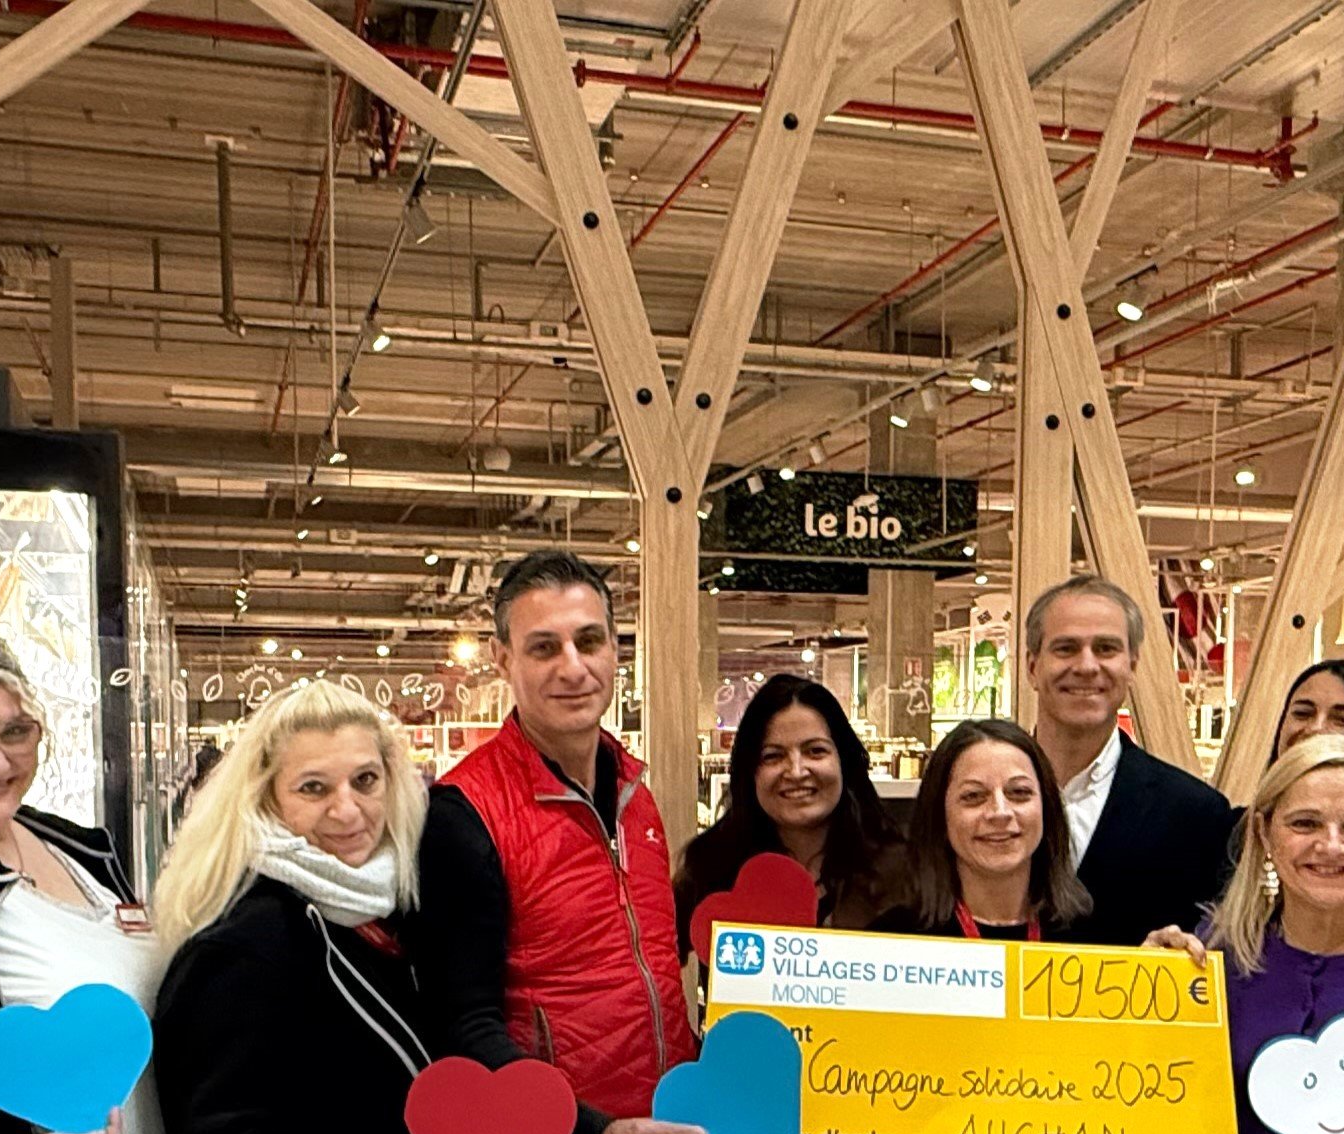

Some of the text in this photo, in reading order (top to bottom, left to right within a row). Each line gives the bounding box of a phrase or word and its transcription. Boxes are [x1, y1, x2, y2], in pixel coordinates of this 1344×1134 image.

[805, 503, 902, 540] le bio
[773, 936, 818, 956] SOS
[772, 958, 1003, 989] VILLAGES D'ENFANTS
[771, 983, 847, 1006] MONDE
[808, 1038, 954, 1111] Campagne
[1092, 1060, 1195, 1107] 2025
